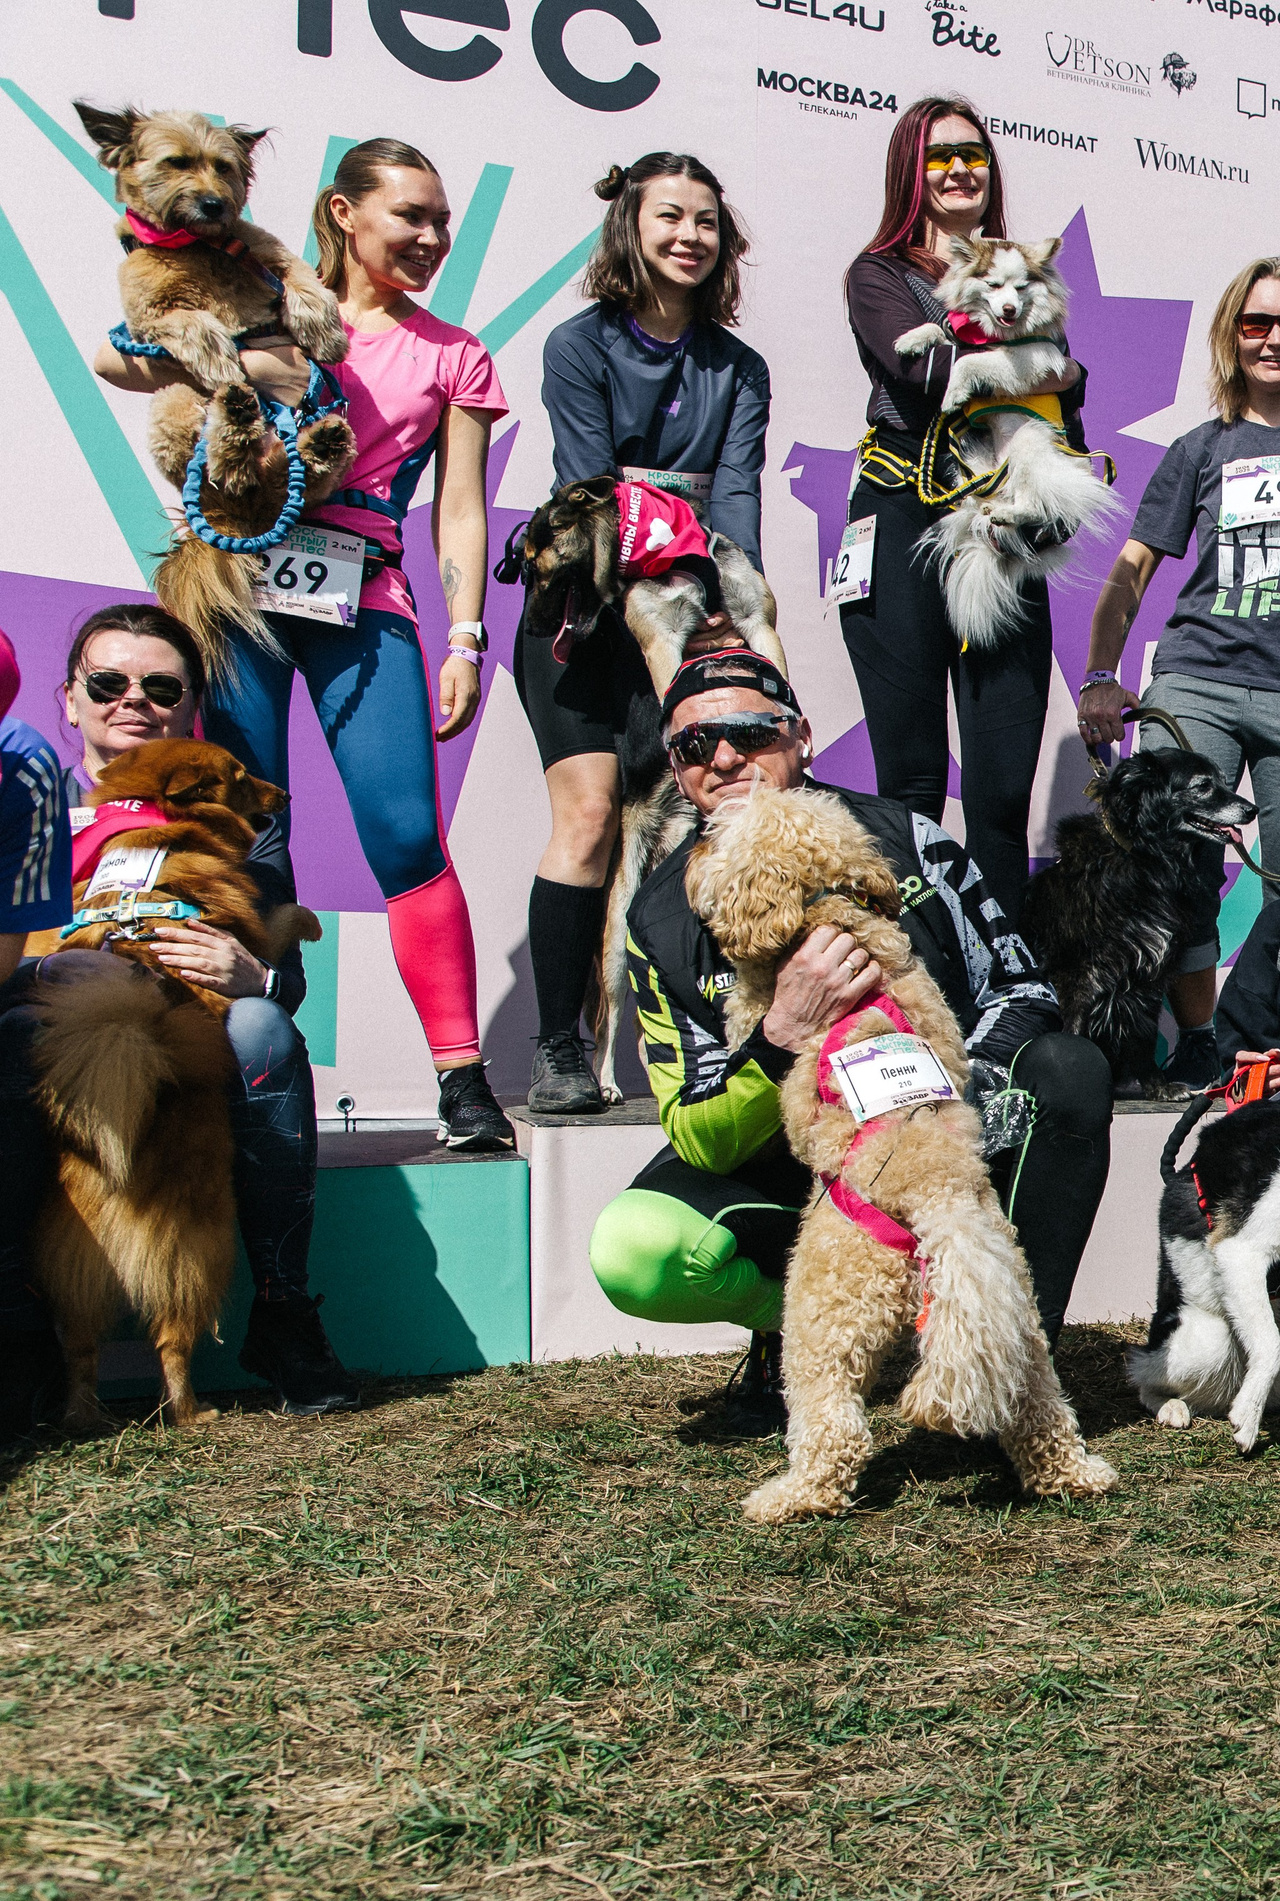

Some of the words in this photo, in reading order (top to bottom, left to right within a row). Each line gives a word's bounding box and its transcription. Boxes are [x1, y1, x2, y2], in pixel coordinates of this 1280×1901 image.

[931, 11, 1001, 57] Bite
[98, 0, 661, 112] ес
[1073, 38, 1101, 57] DR.
[757, 67, 899, 114] МОСКВА24
[1047, 69, 1110, 90] ВЕТЕРИНАРНАЯ
[1111, 82, 1152, 98] КЛИНИКА
[798, 101, 858, 121] ТЕЛЕКАНАЛ
[332, 541, 339, 549] 2
[880, 1064, 918, 1080] Пенни
[898, 1080, 913, 1088] 210
